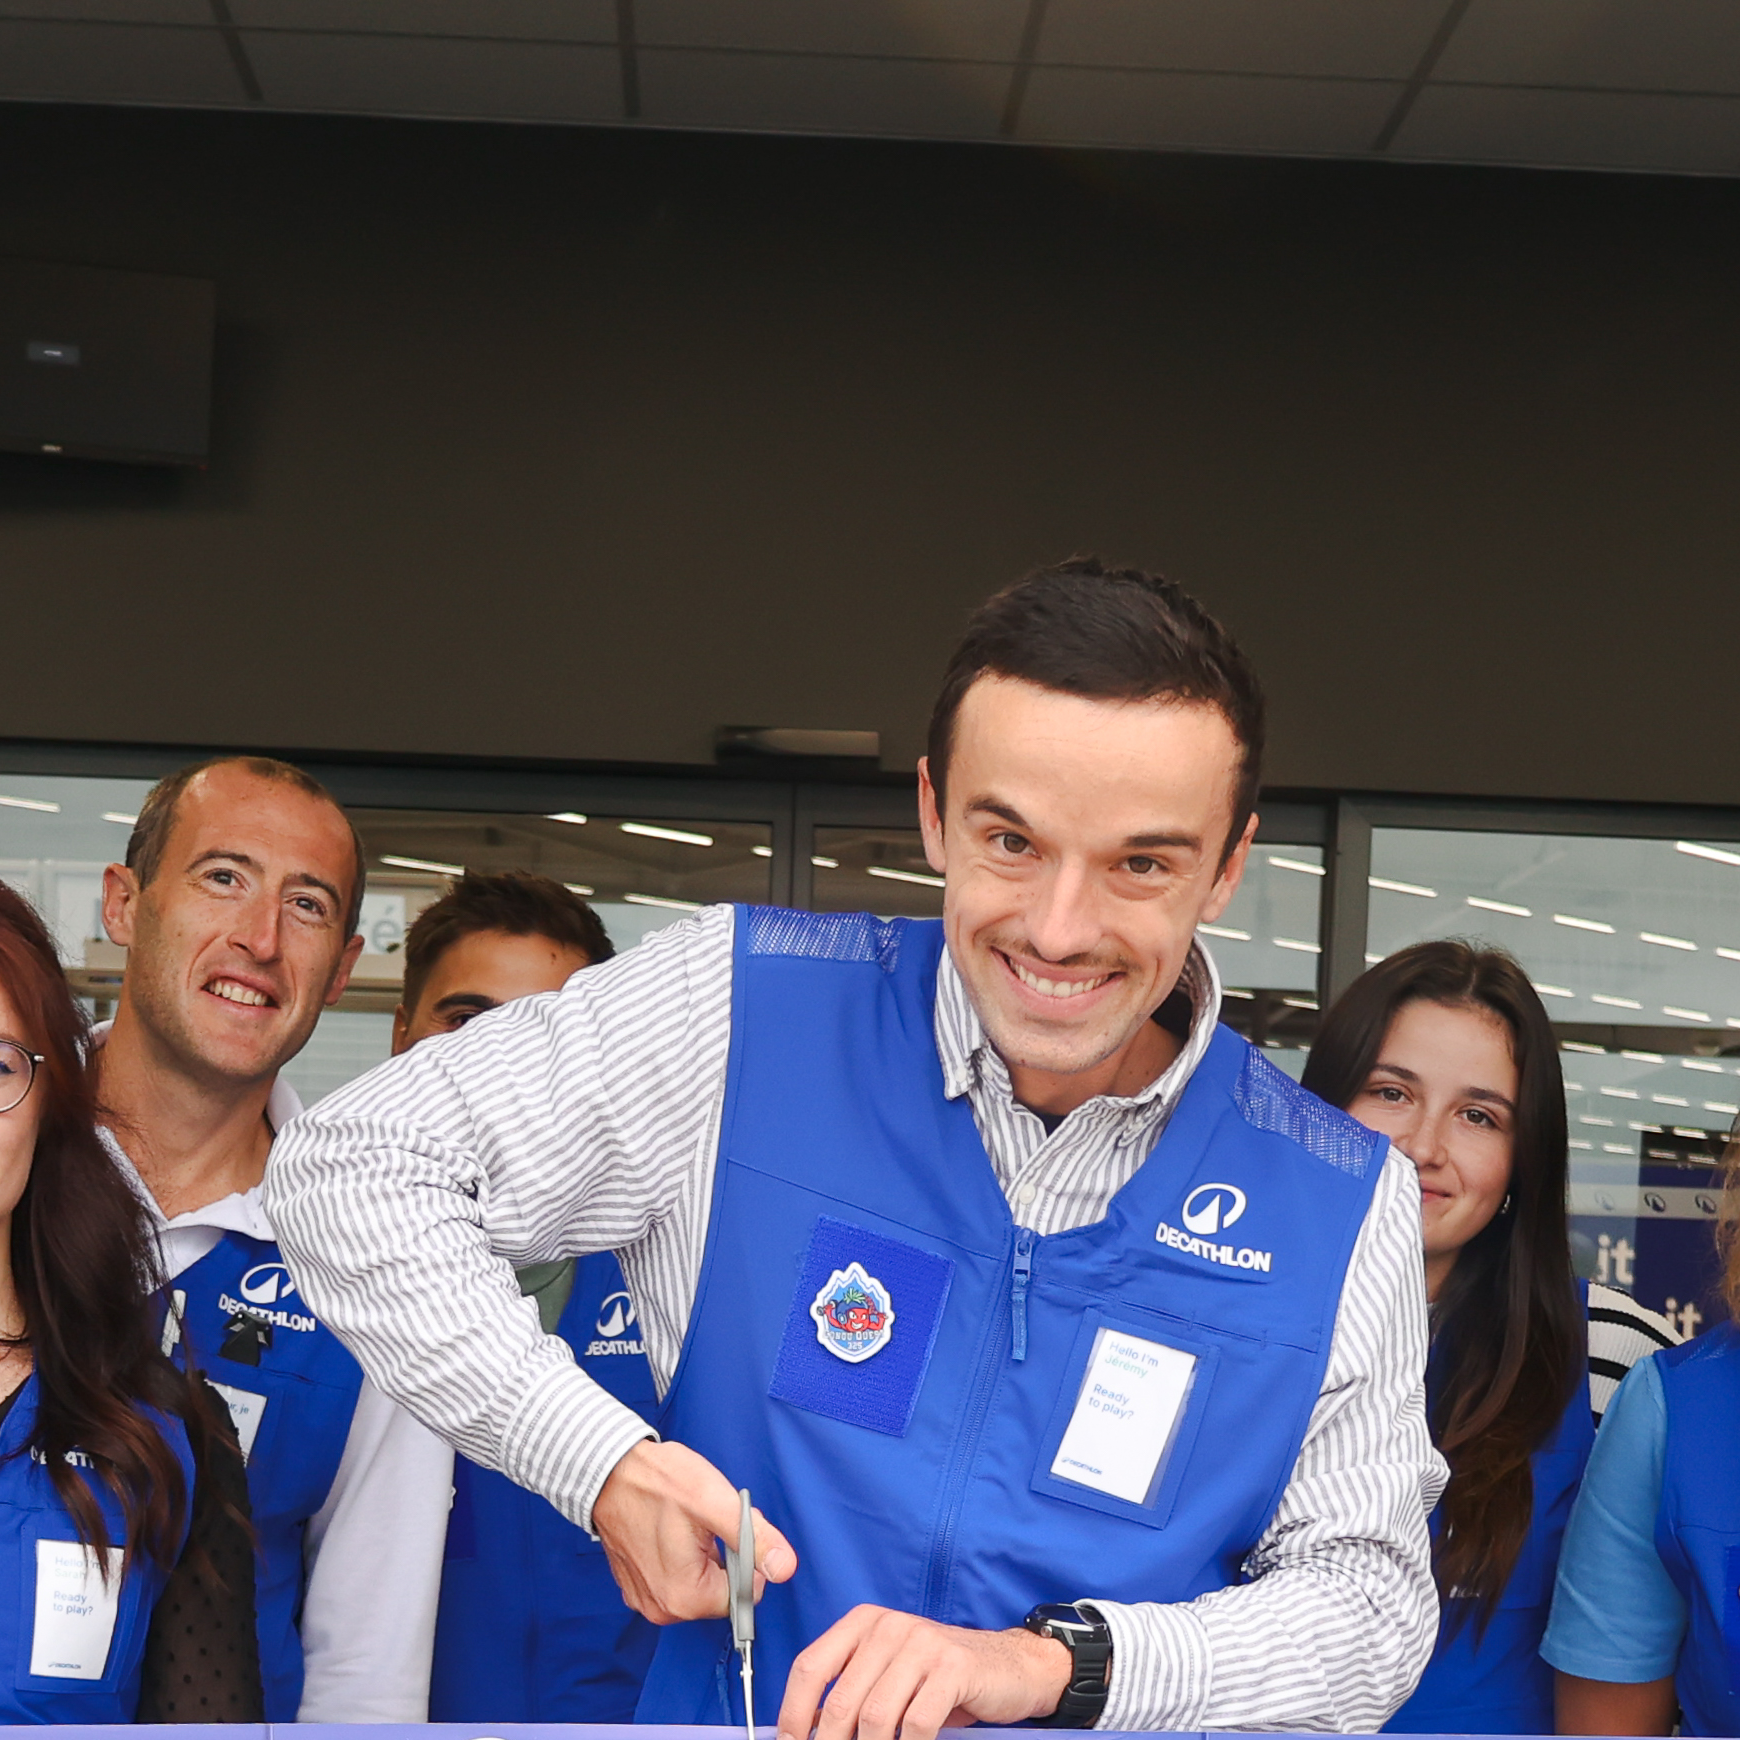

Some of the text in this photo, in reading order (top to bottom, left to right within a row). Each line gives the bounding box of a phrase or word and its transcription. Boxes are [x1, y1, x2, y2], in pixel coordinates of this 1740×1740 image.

[1155, 1221, 1272, 1273] DECATHLON
[584, 1339, 647, 1356] ECATHL
[1109, 1341, 1159, 1367] Hello I'm
[1105, 1355, 1148, 1379] Jérémy
[1093, 1383, 1130, 1407] Ready
[1088, 1396, 1134, 1420] to play?
[53, 1590, 87, 1604] Ready
[53, 1603, 94, 1617] to play?
